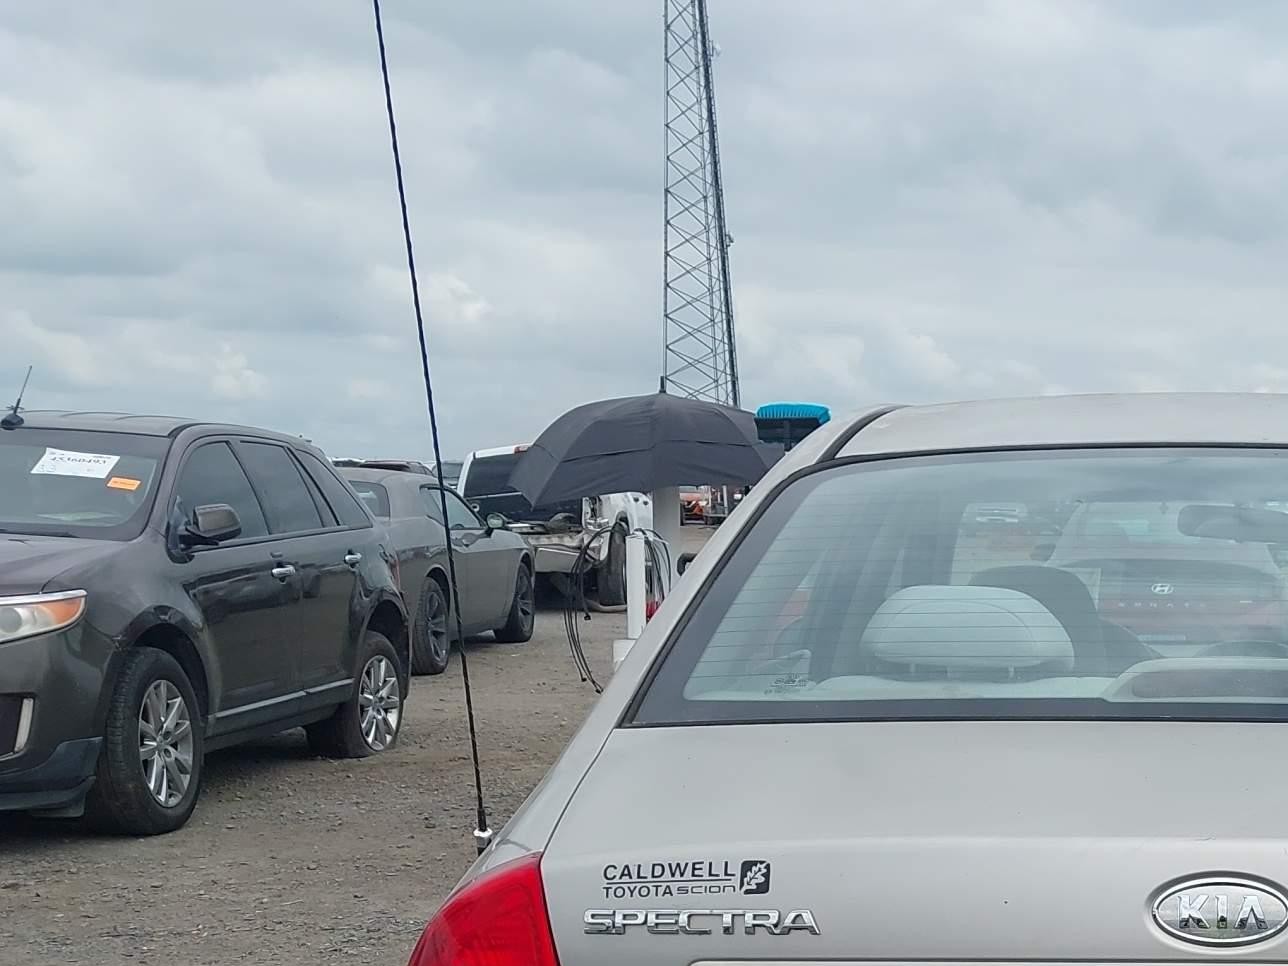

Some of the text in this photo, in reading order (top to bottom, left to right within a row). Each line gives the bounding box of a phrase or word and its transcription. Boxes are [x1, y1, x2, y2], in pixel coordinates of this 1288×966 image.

[602, 860, 736, 881] CALDWELL
[602, 884, 674, 899] TOYOTA
[583, 908, 821, 936] SPECTRA
[1177, 894, 1268, 929] KIA
